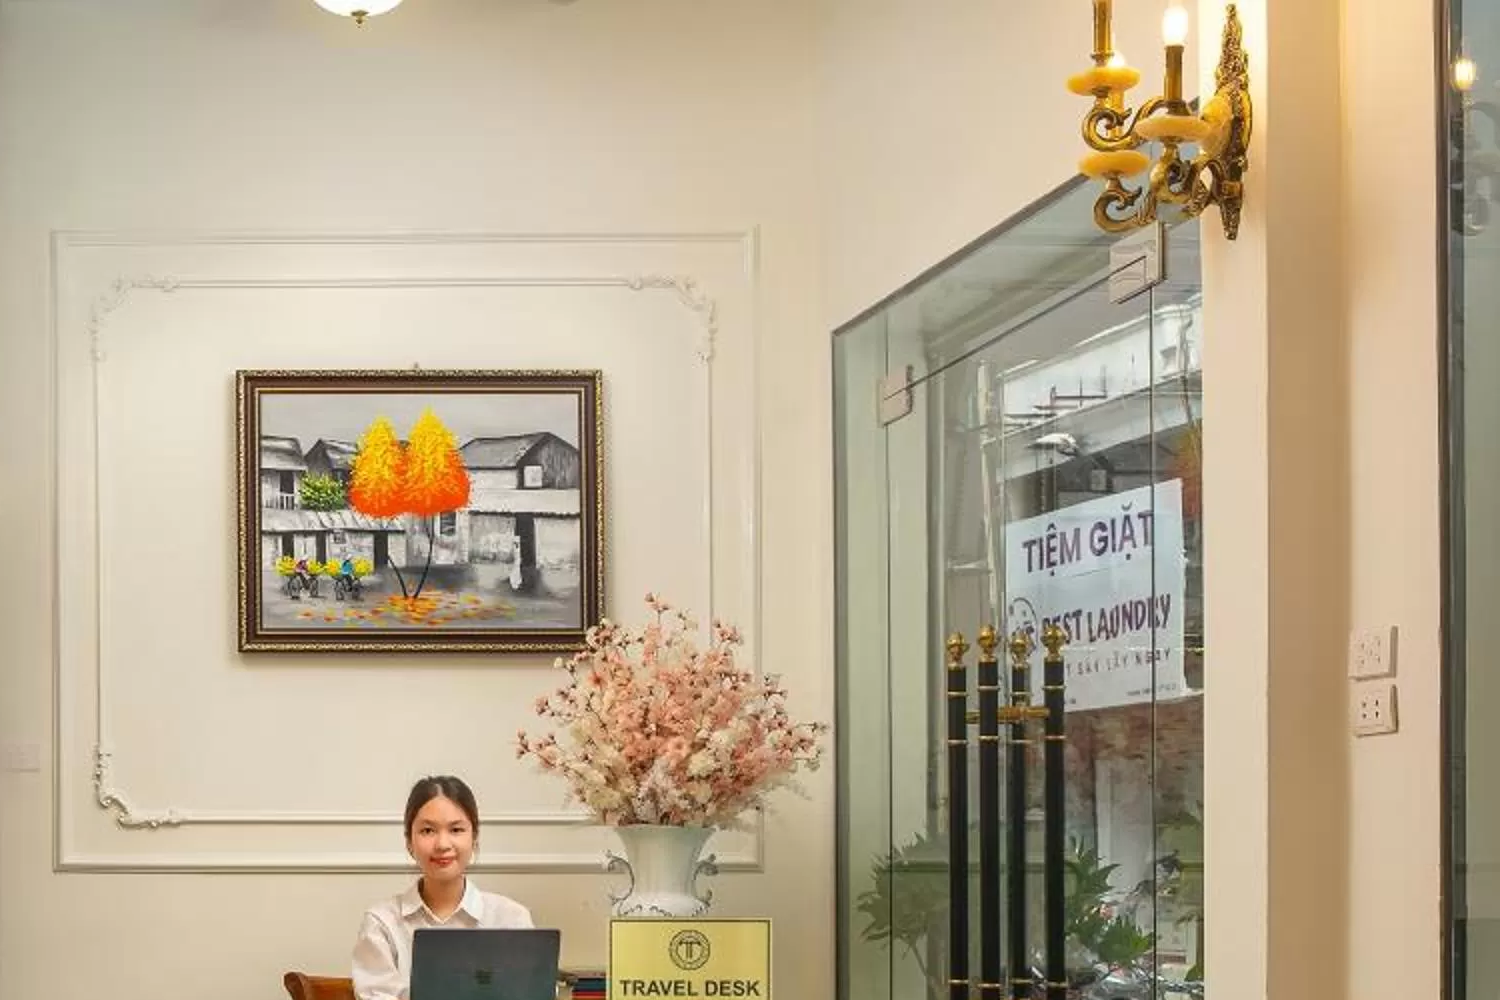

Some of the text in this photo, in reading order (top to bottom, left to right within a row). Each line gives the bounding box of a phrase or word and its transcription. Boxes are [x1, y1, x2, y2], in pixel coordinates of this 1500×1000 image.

[1022, 501, 1155, 577] TIỆM GIẶT
[1087, 593, 1171, 643] LAUNDRY
[619, 979, 760, 997] TRAVEL DESK
